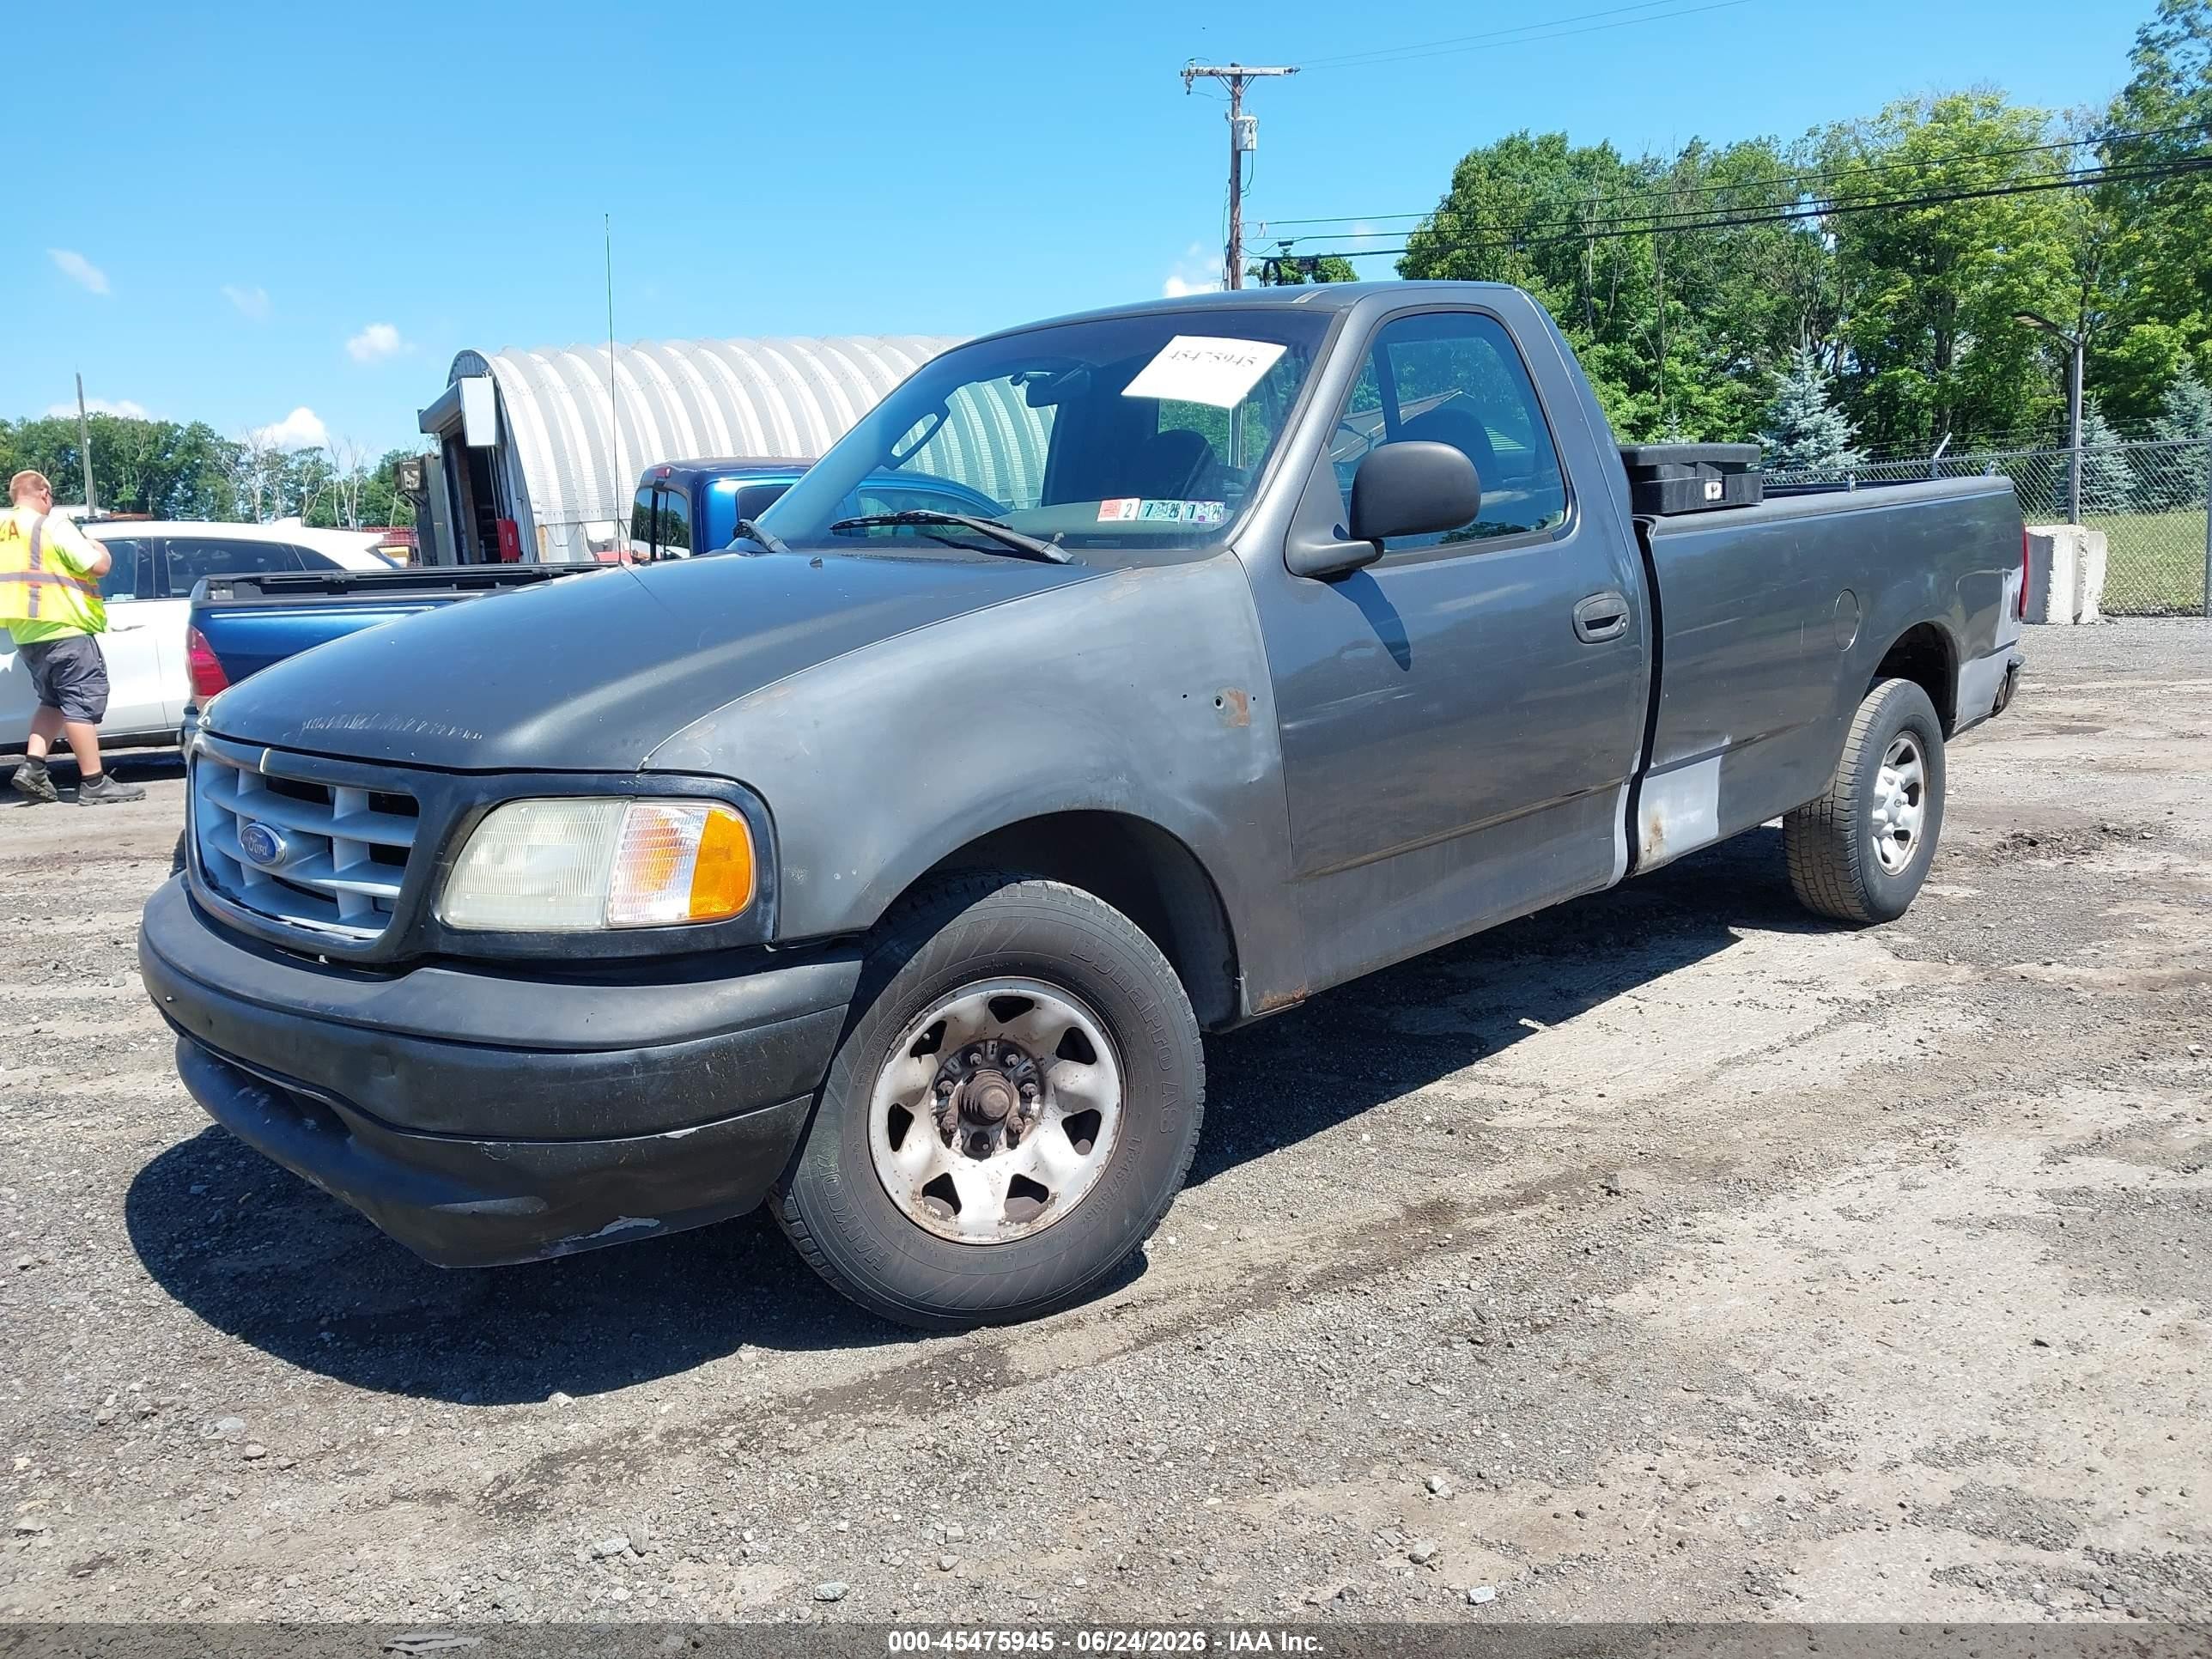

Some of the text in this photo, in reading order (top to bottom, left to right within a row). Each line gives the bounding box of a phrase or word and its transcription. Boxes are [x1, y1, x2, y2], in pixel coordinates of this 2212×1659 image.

[1146, 503, 1153, 518] 7
[1188, 504, 1195, 520] 7
[248, 831, 269, 857] Ford
